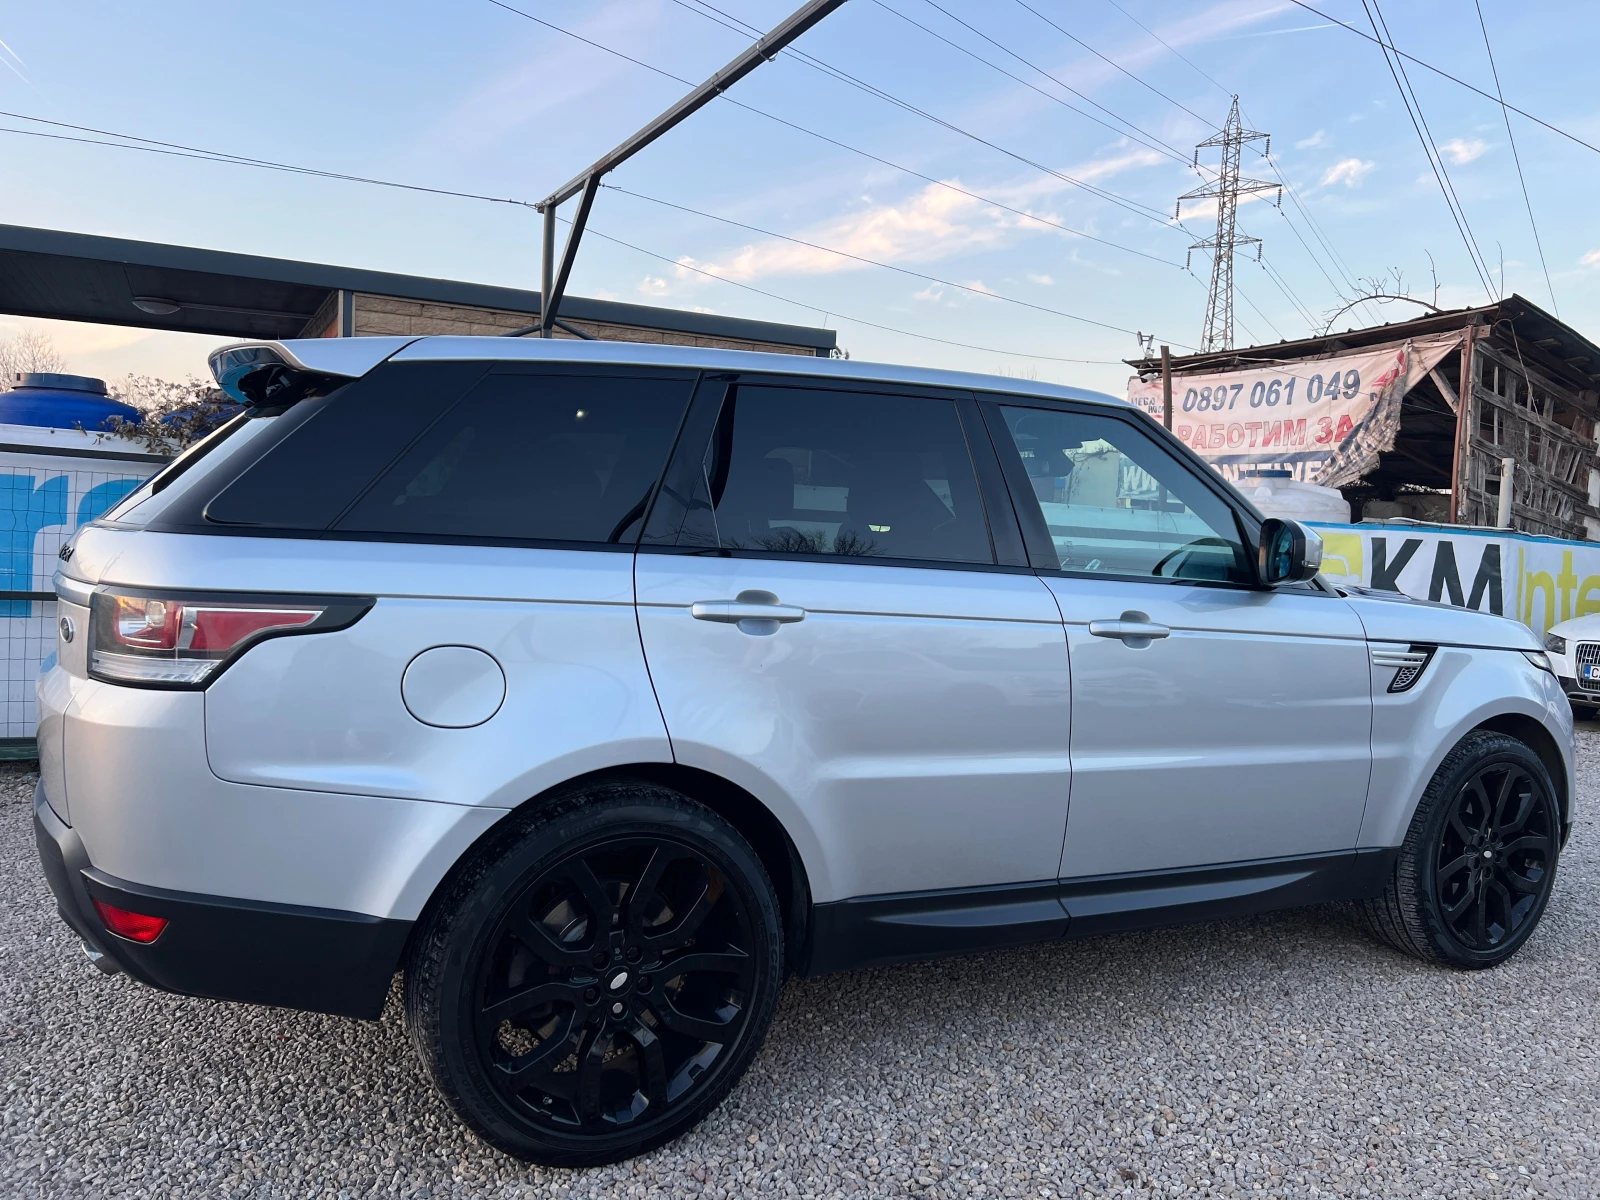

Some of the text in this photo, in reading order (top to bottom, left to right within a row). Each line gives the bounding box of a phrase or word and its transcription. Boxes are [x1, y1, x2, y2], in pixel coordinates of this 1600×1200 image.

[1182, 369, 1361, 412] 0897 061 049
[1177, 414, 1354, 449] РАБОТИМ ЗА
[1371, 537, 1503, 616] KM
